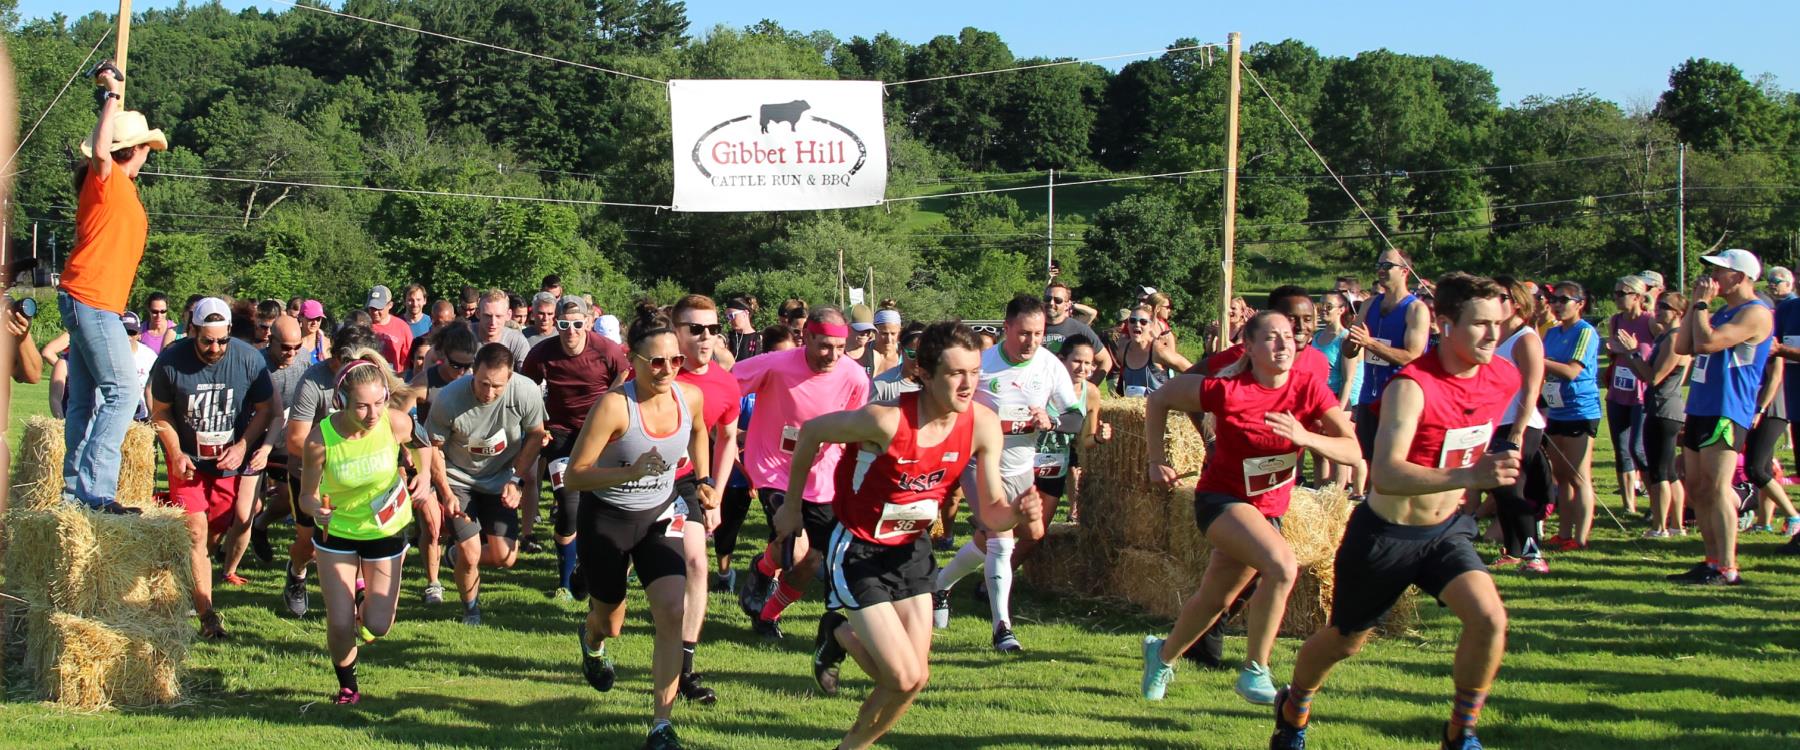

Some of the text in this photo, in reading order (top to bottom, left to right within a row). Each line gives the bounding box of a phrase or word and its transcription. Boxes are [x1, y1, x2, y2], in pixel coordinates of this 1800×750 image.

[711, 140, 846, 164] Gibbet Hill
[711, 174, 851, 187] CATTLE RUN & BBQ
[187, 388, 234, 418] KILL
[1011, 421, 1026, 434] 62
[1461, 448, 1474, 466] 5
[898, 468, 947, 492] USA
[1268, 472, 1278, 485] 4
[893, 520, 916, 531] 36
